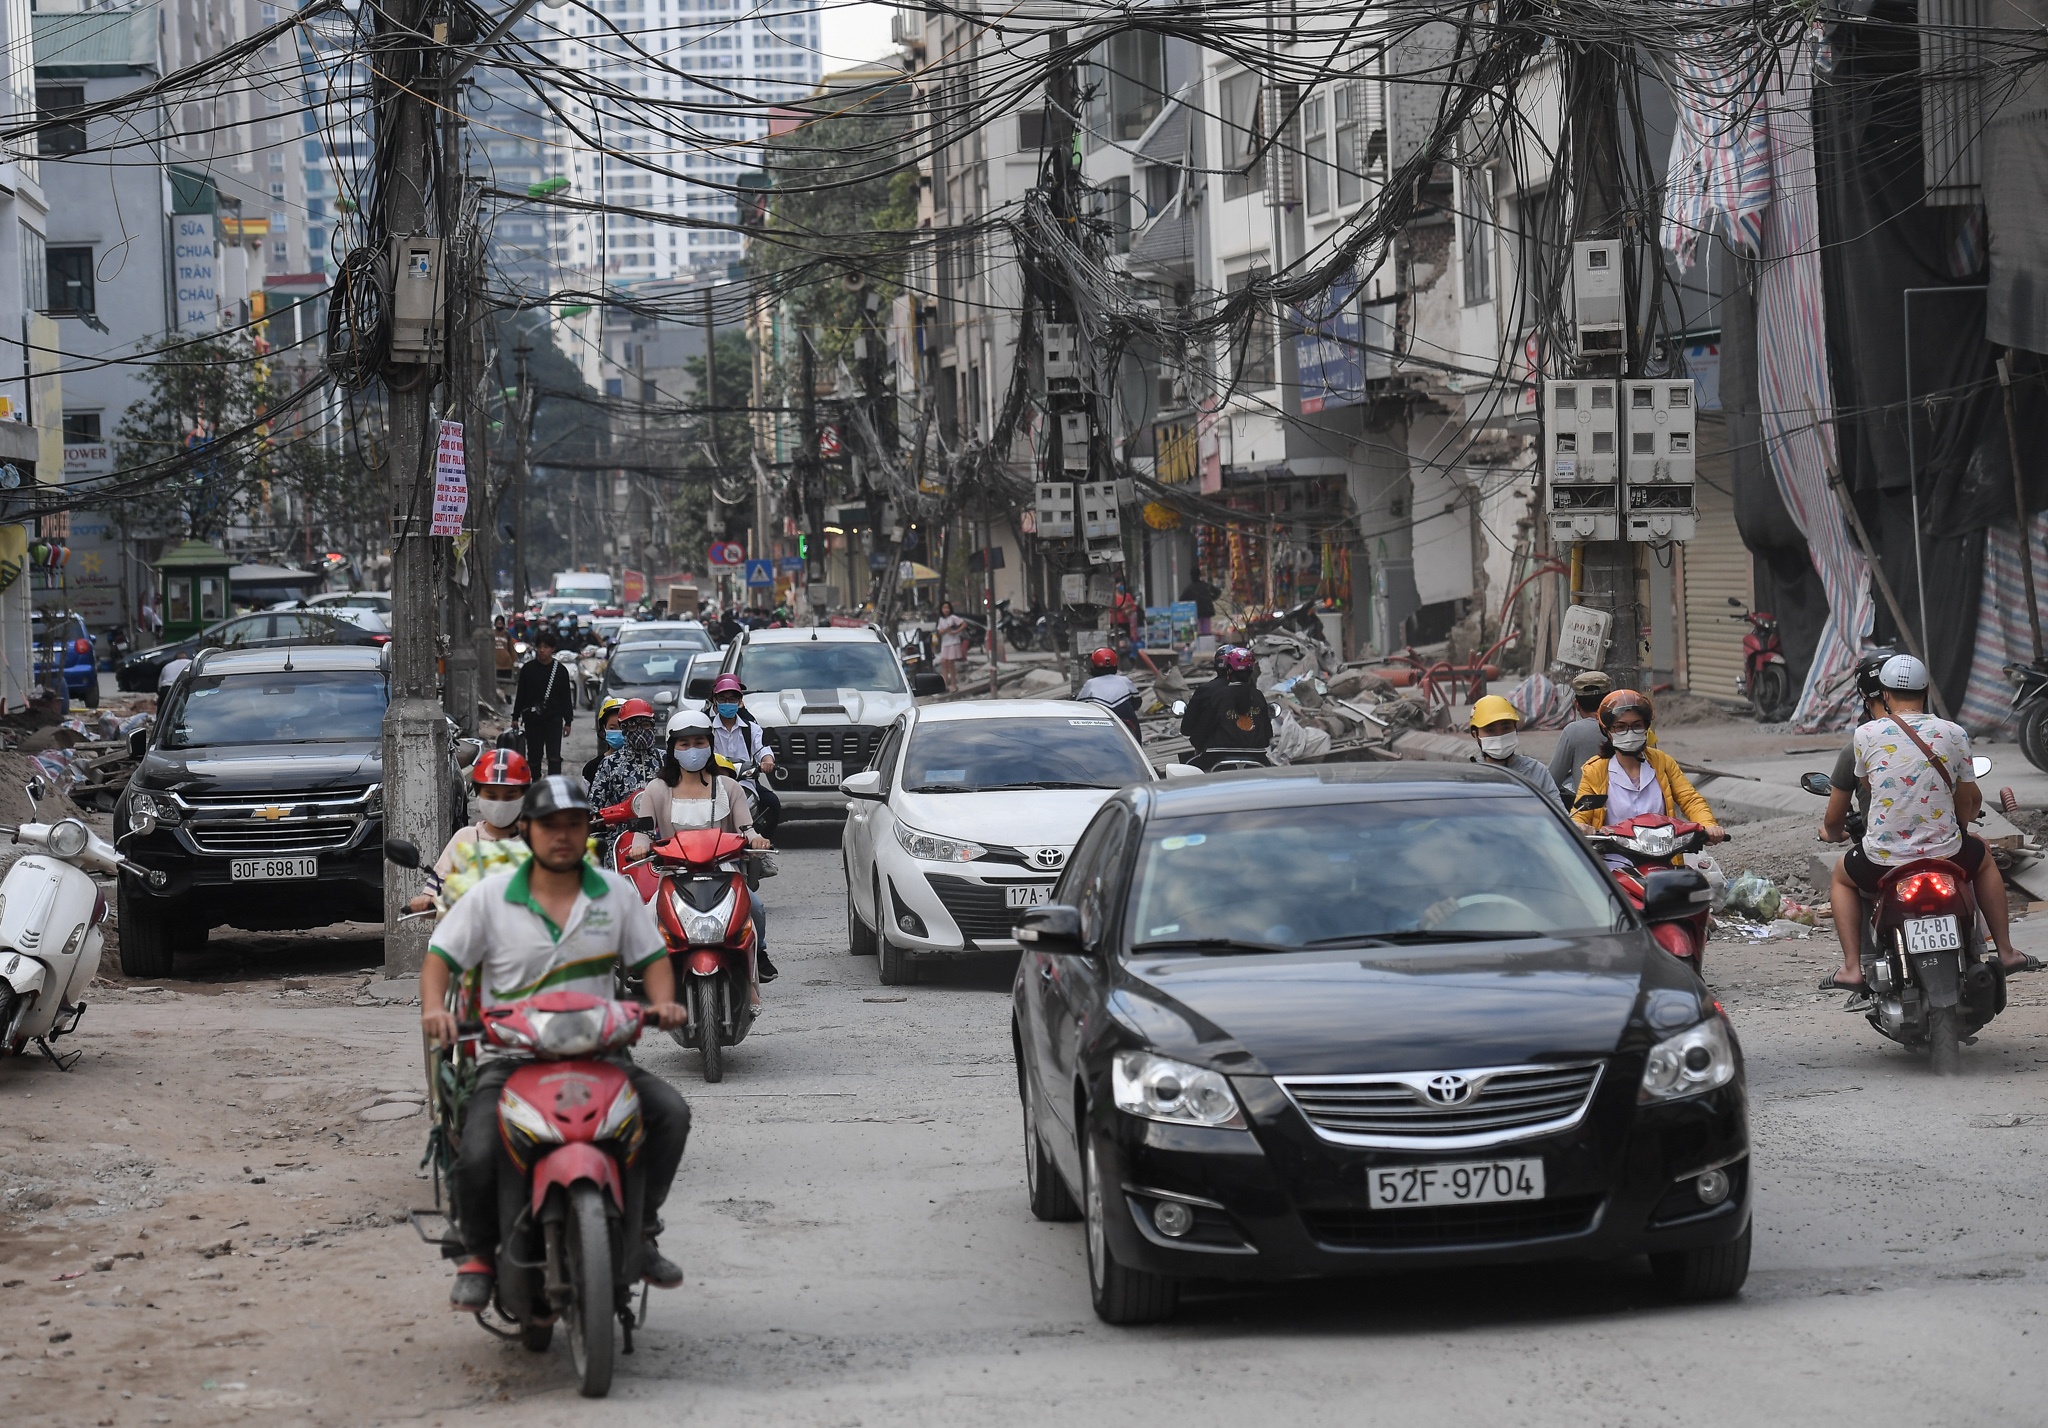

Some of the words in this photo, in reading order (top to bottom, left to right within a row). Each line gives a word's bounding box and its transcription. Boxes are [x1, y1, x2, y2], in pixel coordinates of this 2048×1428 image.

[180, 220, 205, 236] SỮA
[176, 245, 212, 258] CHUA
[179, 263, 212, 279] TRÂN
[178, 284, 214, 301] CHÂU
[187, 310, 206, 325] HẠ
[816, 762, 835, 774] 29H
[809, 774, 841, 785] 024.01
[233, 859, 316, 879] 30F-698.10
[1912, 917, 1949, 936] 24-B1
[1911, 932, 1957, 950] 416.66
[1378, 1164, 1534, 1204] 52F-9704
